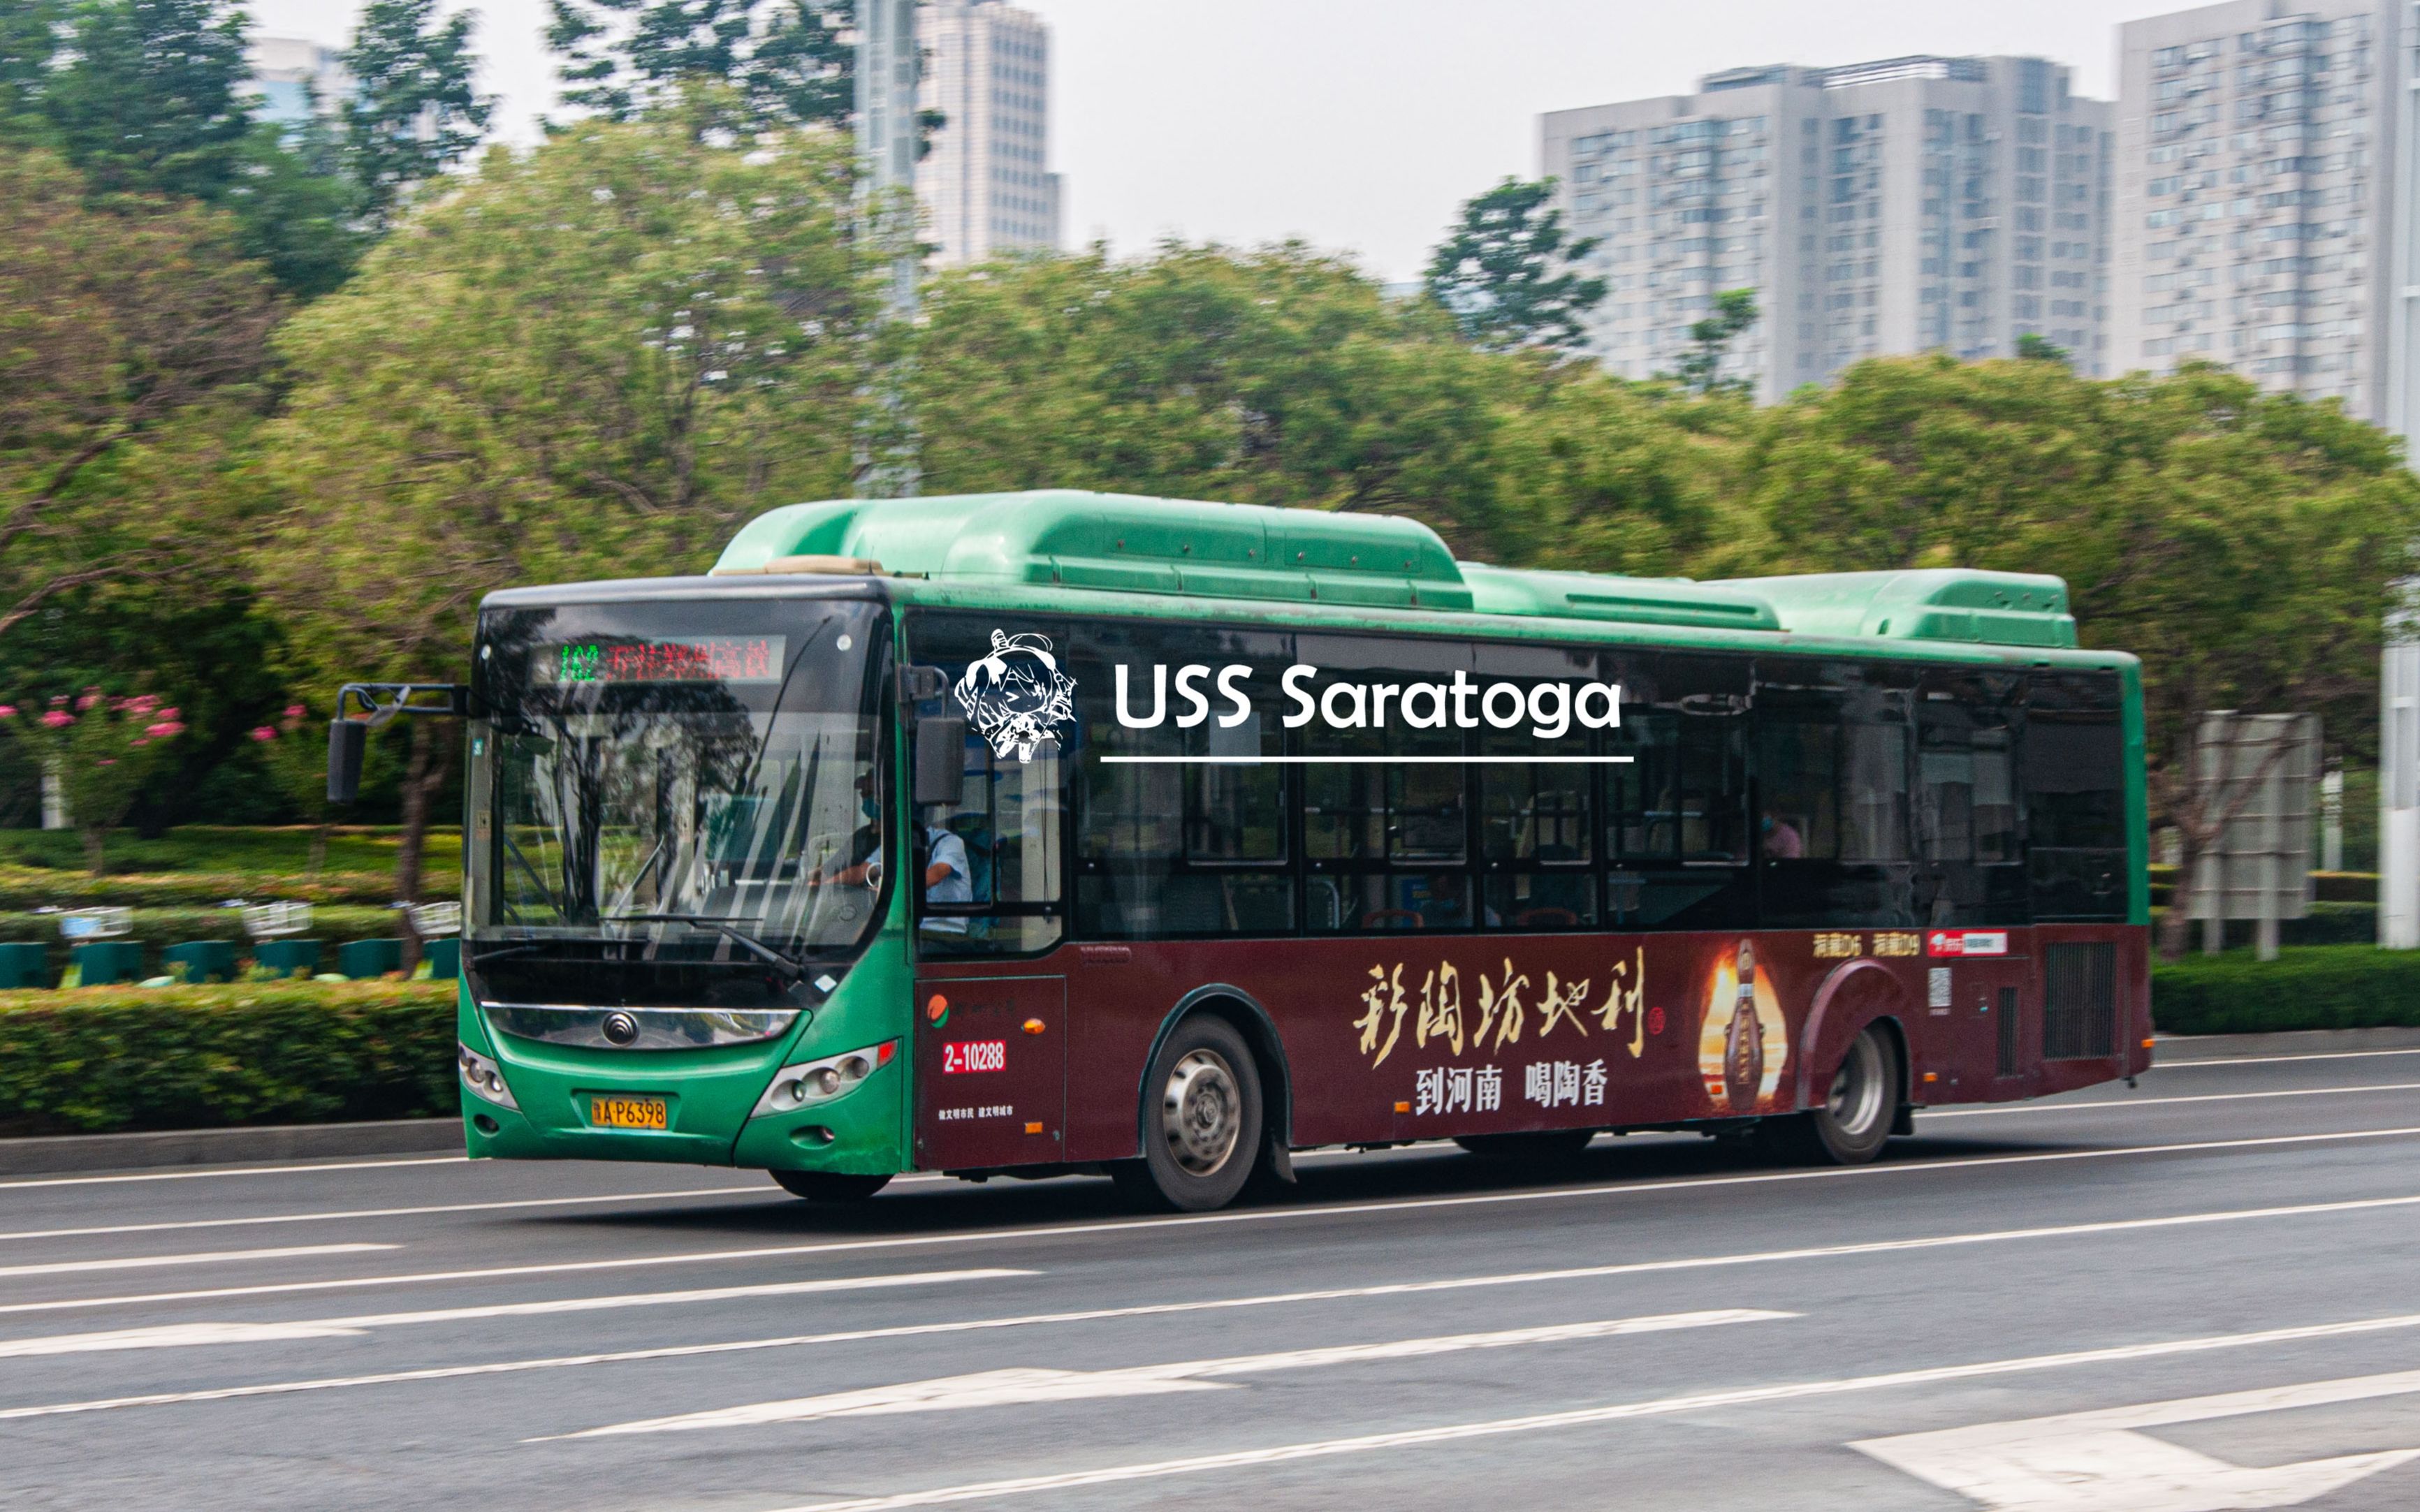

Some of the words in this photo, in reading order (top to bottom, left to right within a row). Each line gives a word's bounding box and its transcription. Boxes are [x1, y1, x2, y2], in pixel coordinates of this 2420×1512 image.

[1353, 946, 1644, 1069] 彩陶坊地利
[945, 1042, 1004, 1071] 2-10288
[1416, 1064, 1503, 1116] 到河南
[1525, 1058, 1608, 1108] 喝陶香
